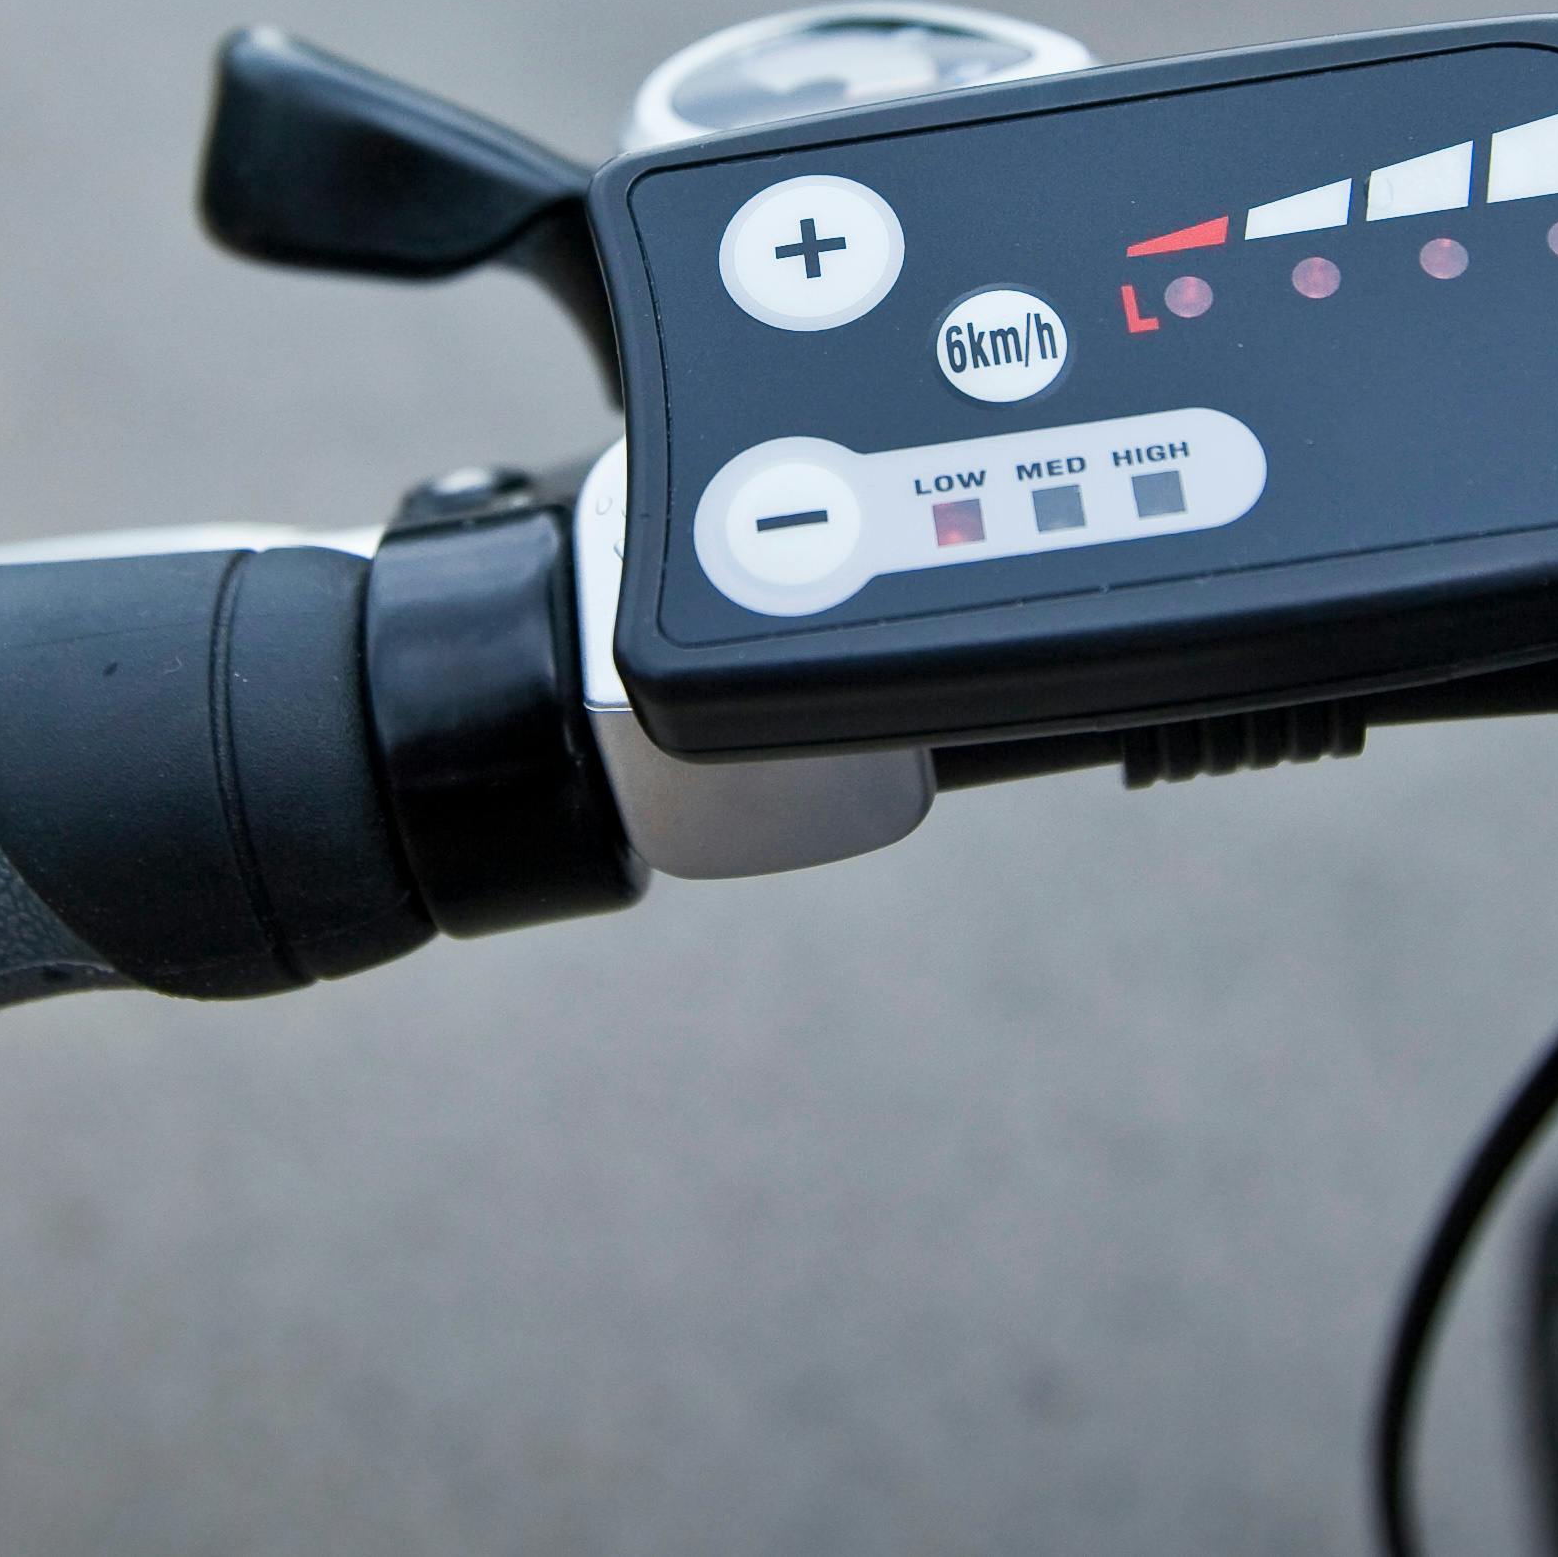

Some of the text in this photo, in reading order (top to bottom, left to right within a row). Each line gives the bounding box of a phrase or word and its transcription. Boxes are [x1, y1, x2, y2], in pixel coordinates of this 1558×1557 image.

[1121, 284, 1160, 333] L
[945, 312, 1058, 374] 6km/h
[914, 441, 1190, 496] LOW MED HIGH
